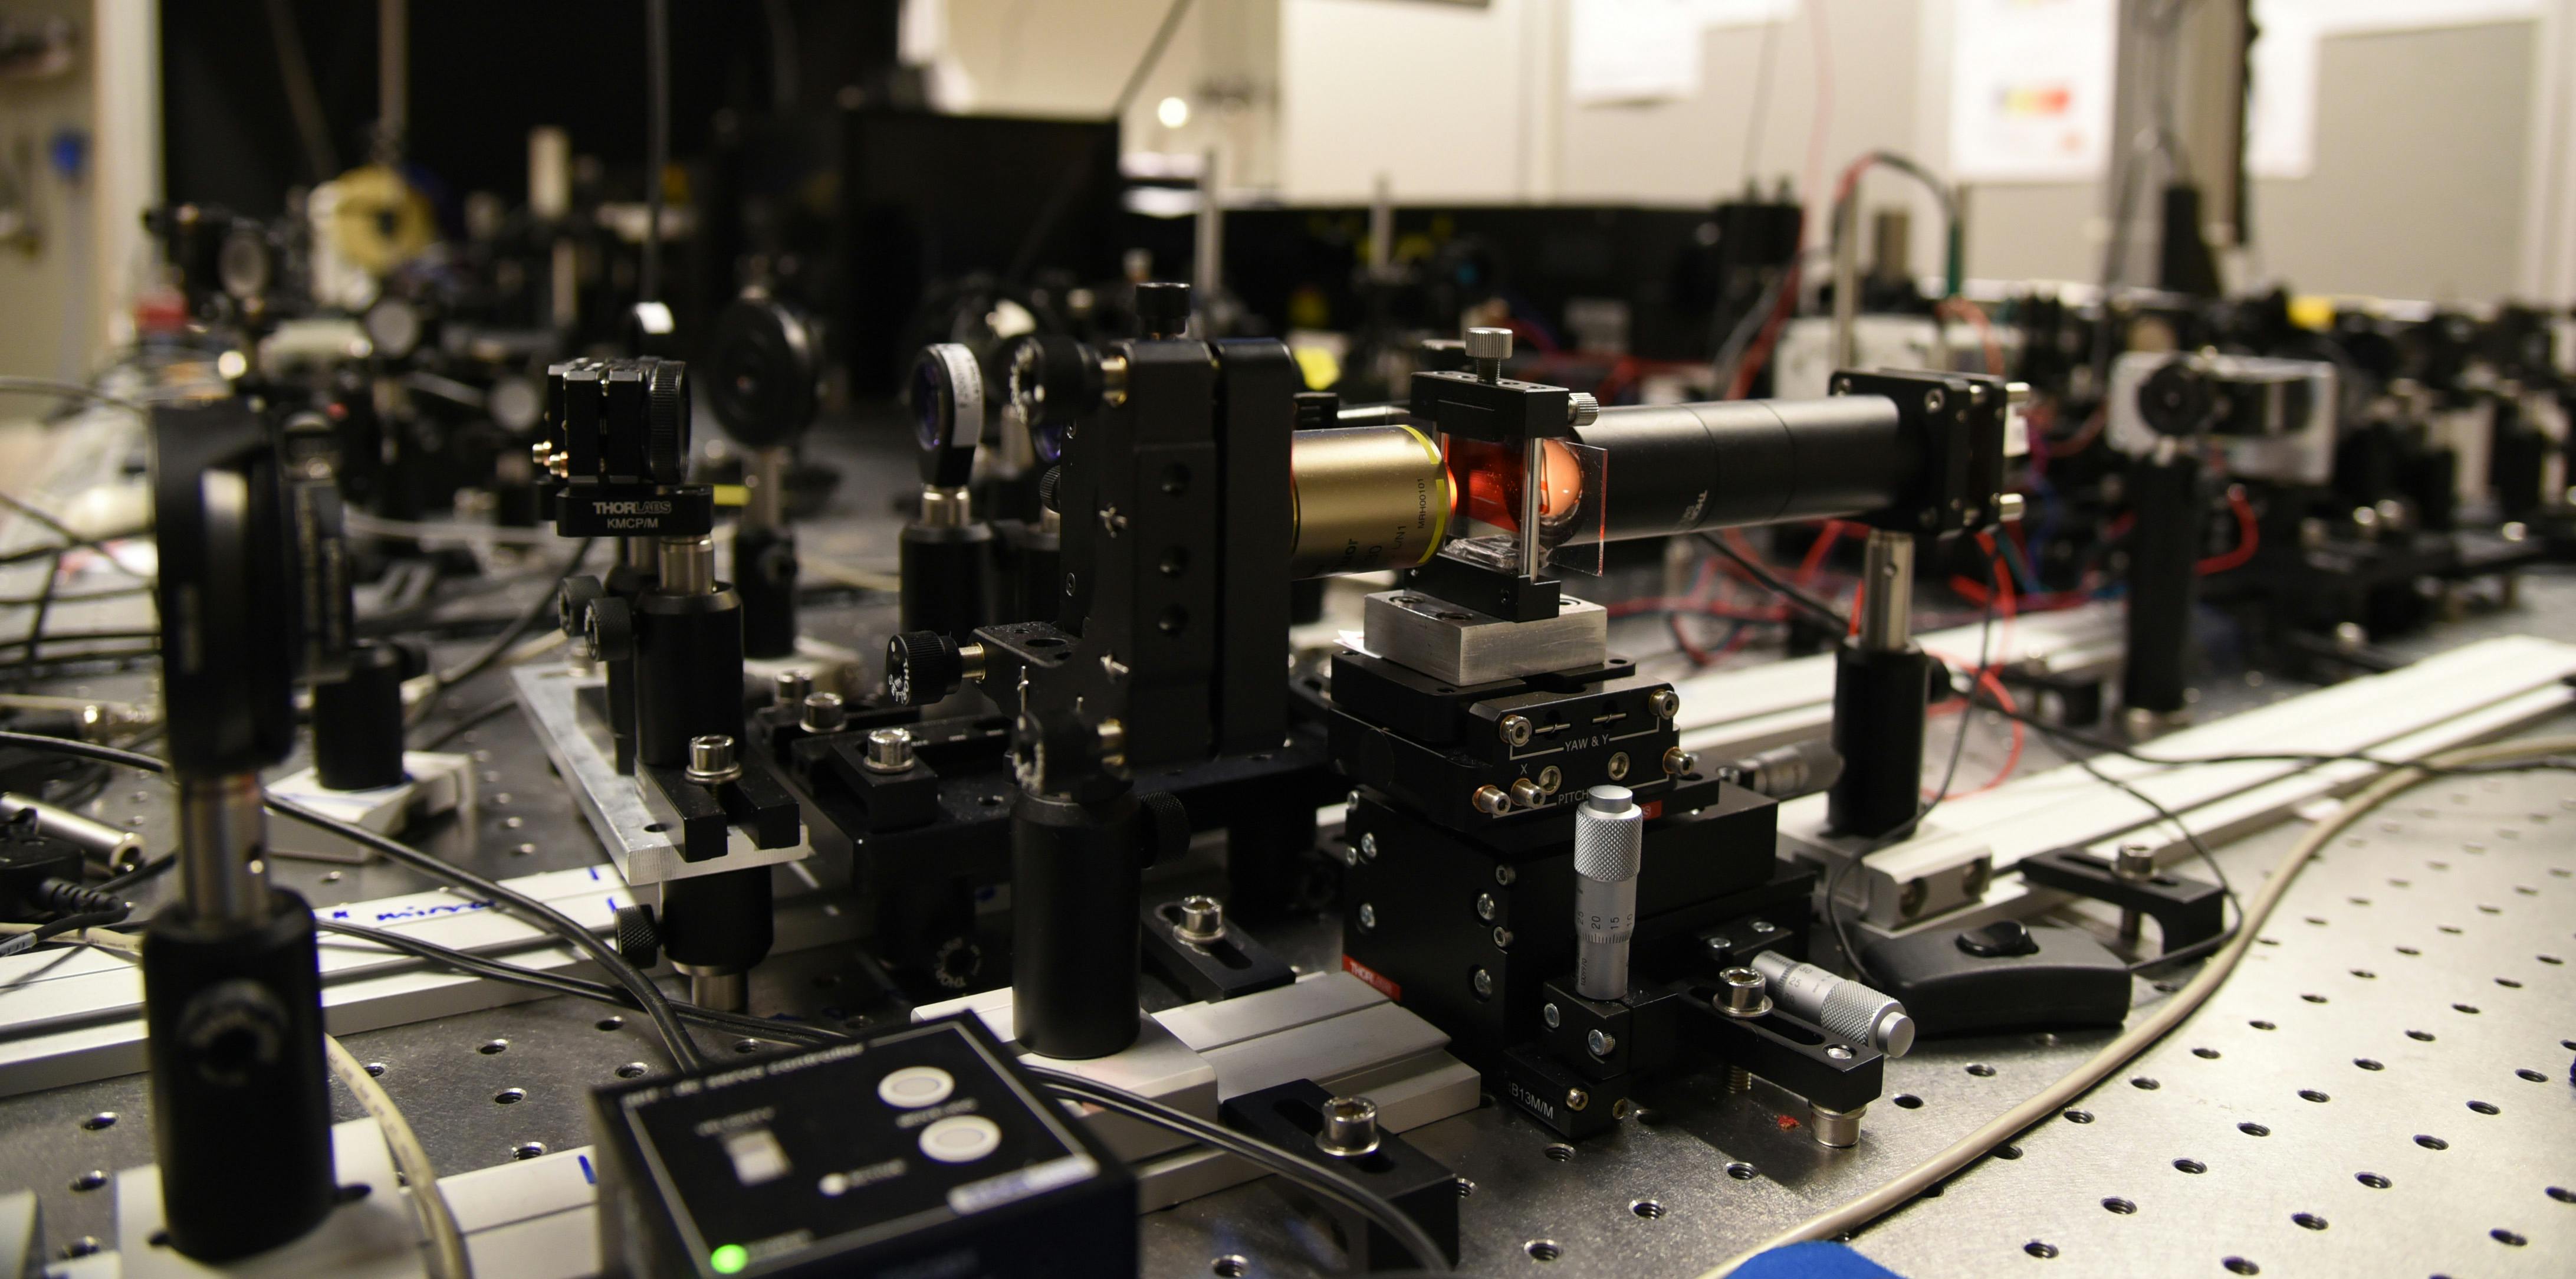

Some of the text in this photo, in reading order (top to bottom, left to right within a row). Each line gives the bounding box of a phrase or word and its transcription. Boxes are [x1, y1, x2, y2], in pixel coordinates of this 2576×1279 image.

[593, 501, 672, 514] THORLABS
[1417, 478, 1426, 529] MRH00101
[607, 518, 659, 529] KMCP/M
[1565, 734, 1609, 752] YAW & Y
[1520, 764, 1527, 775] X
[1558, 790, 1589, 805] PITCH
[1591, 916, 1601, 930] 20
[1610, 917, 1619, 930] 15
[1789, 976, 1801, 988] 25
